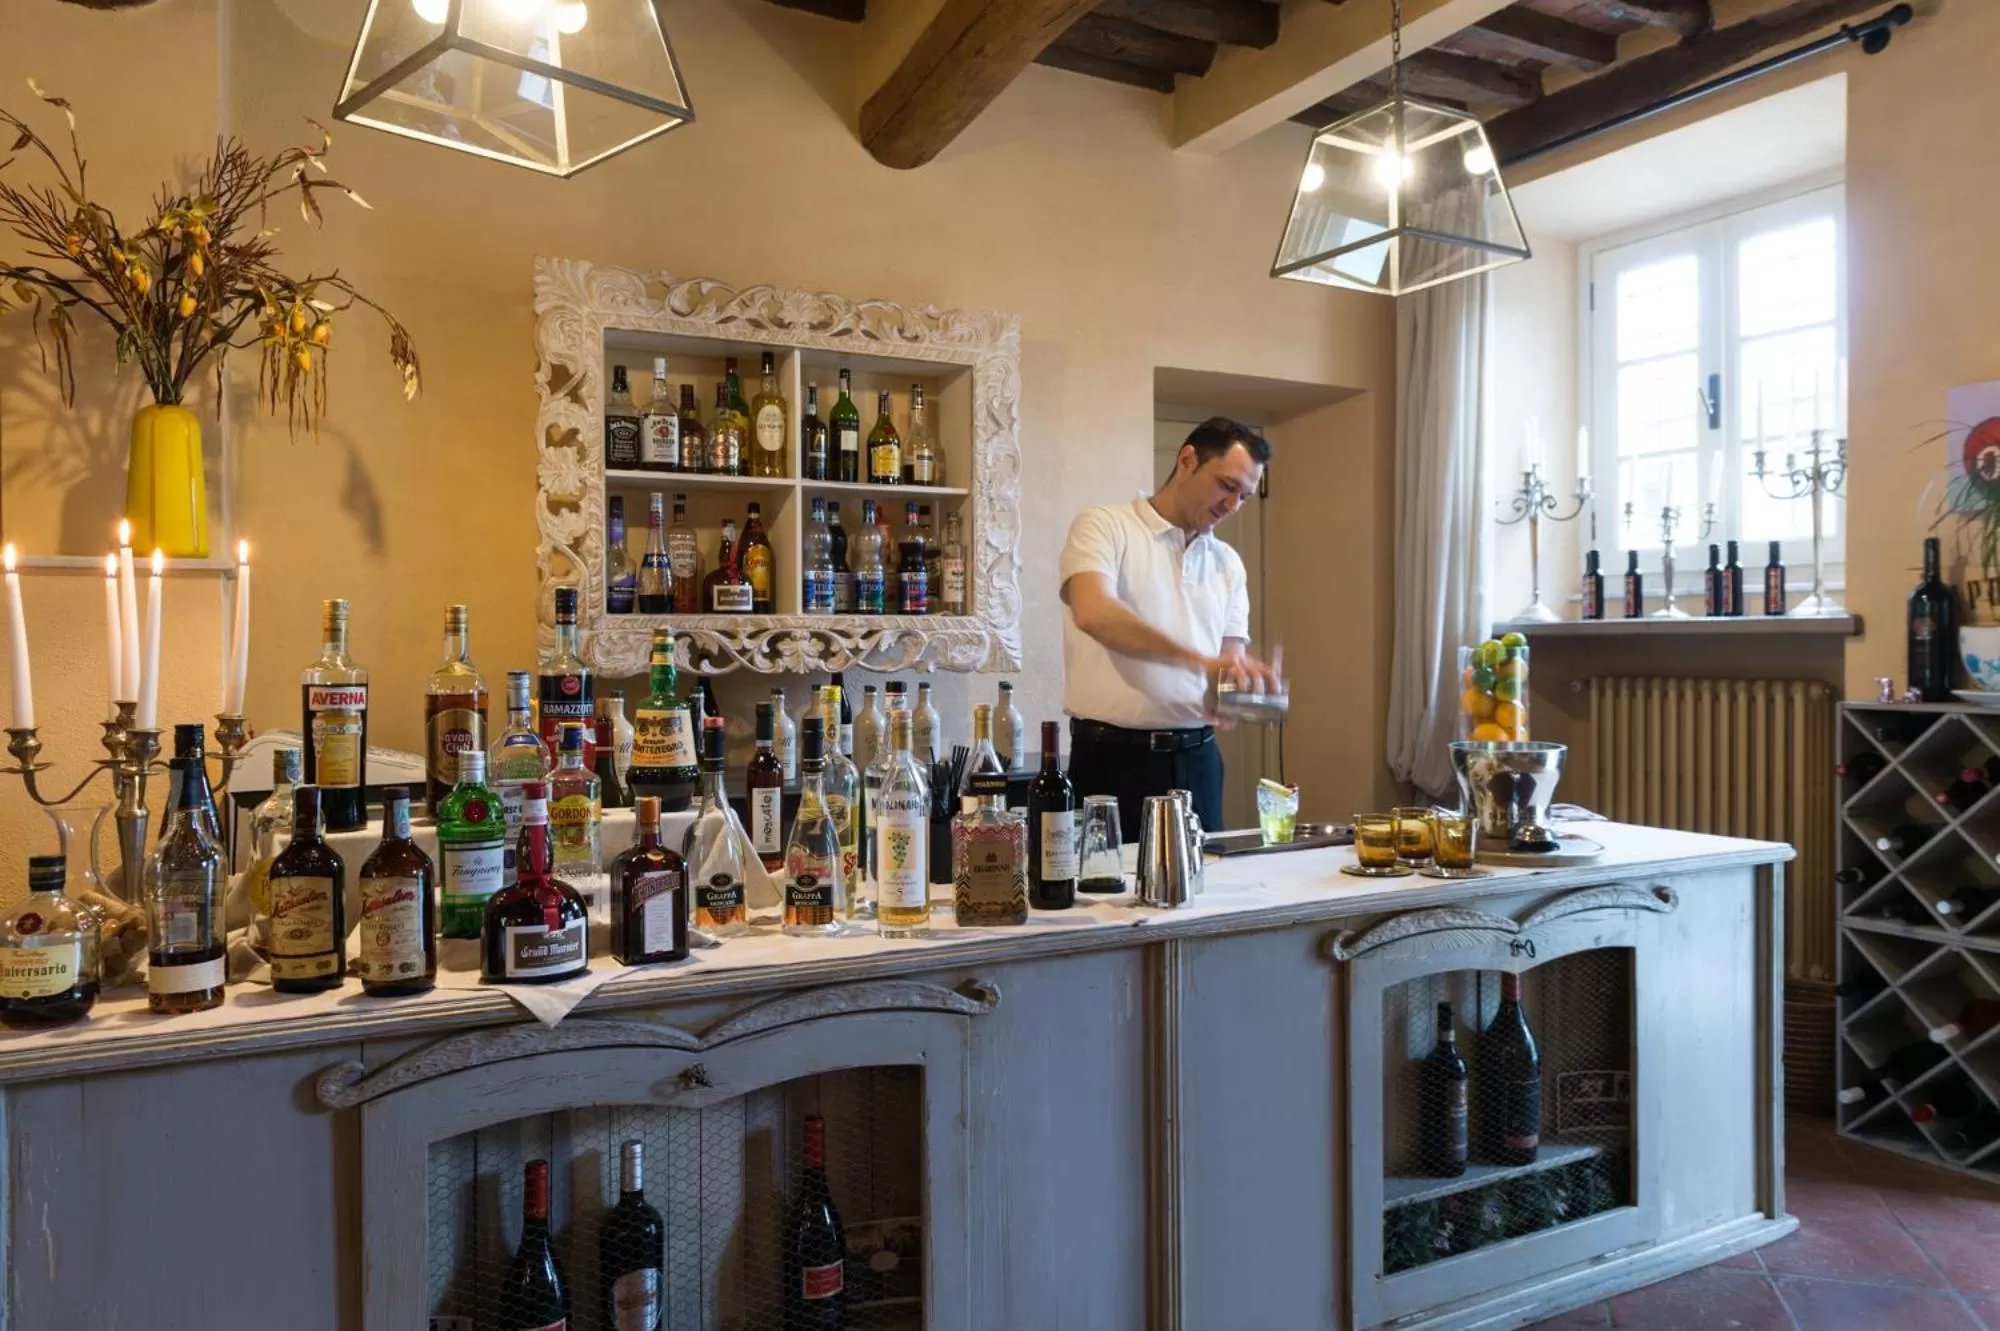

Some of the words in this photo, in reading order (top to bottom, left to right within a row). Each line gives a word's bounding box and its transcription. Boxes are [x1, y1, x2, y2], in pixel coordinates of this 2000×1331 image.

[311, 691, 365, 705] AVERNA
[634, 740, 684, 755] ONTENEGRO
[706, 890, 737, 901] GRAPPA
[791, 890, 822, 901] GRAPPA
[520, 945, 549, 958] Grand
[0, 961, 67, 978] niversario
